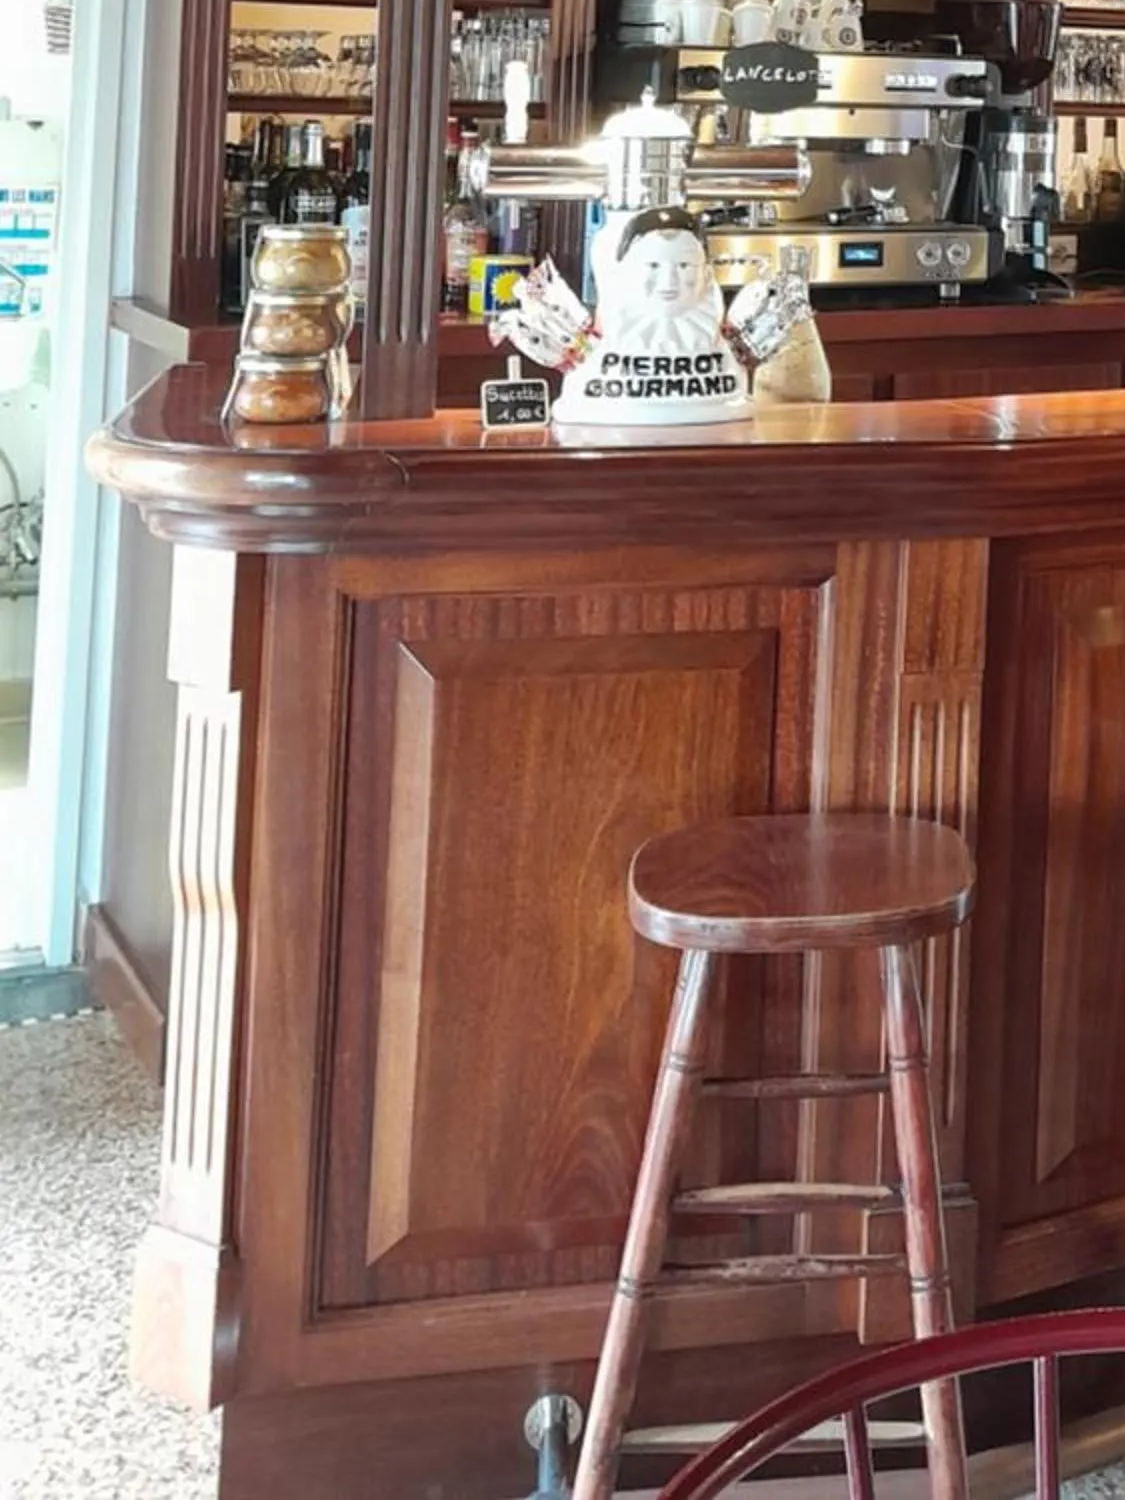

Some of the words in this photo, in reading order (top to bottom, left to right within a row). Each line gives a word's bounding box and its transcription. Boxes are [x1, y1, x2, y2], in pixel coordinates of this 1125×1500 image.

[723, 64, 817, 82] LANCELOT
[601, 352, 725, 376] PIERROT
[585, 374, 736, 398] GOURMAND
